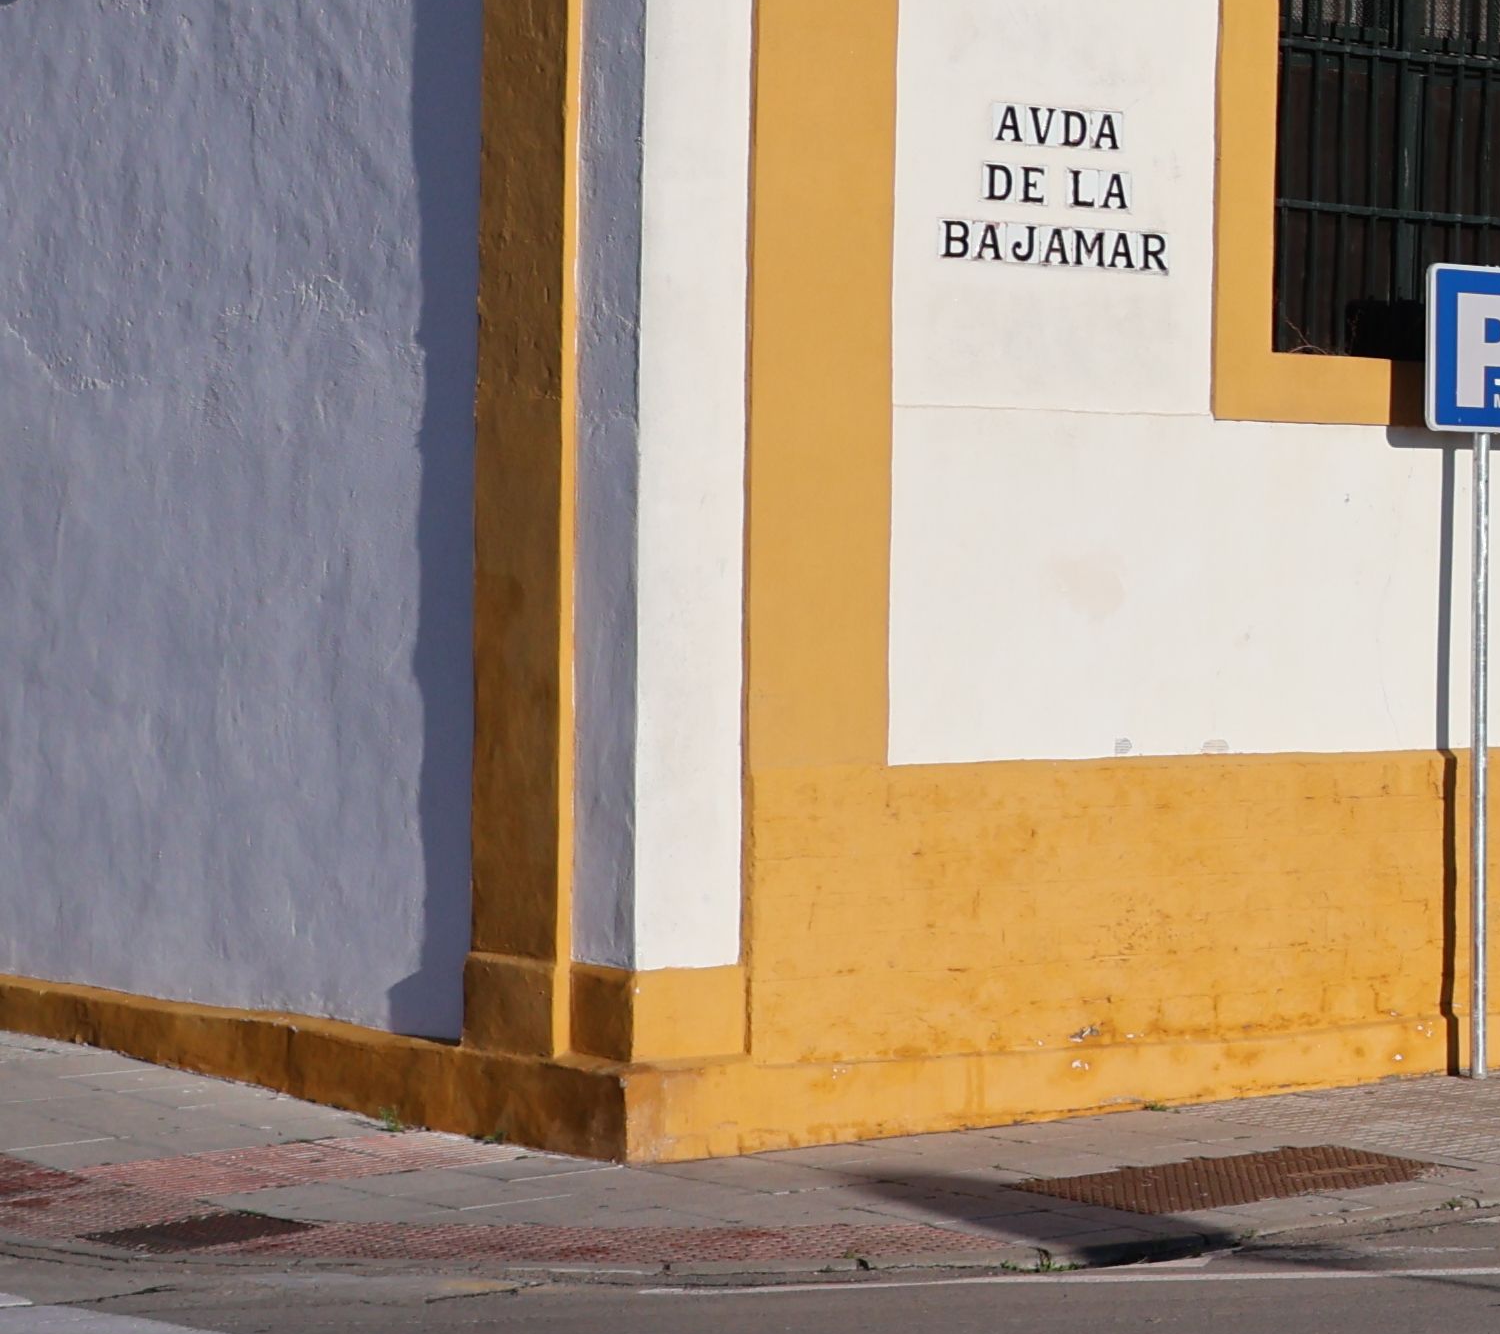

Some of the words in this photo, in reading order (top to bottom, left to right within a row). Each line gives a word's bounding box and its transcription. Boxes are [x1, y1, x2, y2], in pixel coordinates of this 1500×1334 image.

[995, 105, 1119, 150] AVDA
[984, 163, 1045, 203] DE
[1069, 169, 1129, 209] LA
[940, 219, 1168, 275] BAJAMAR
